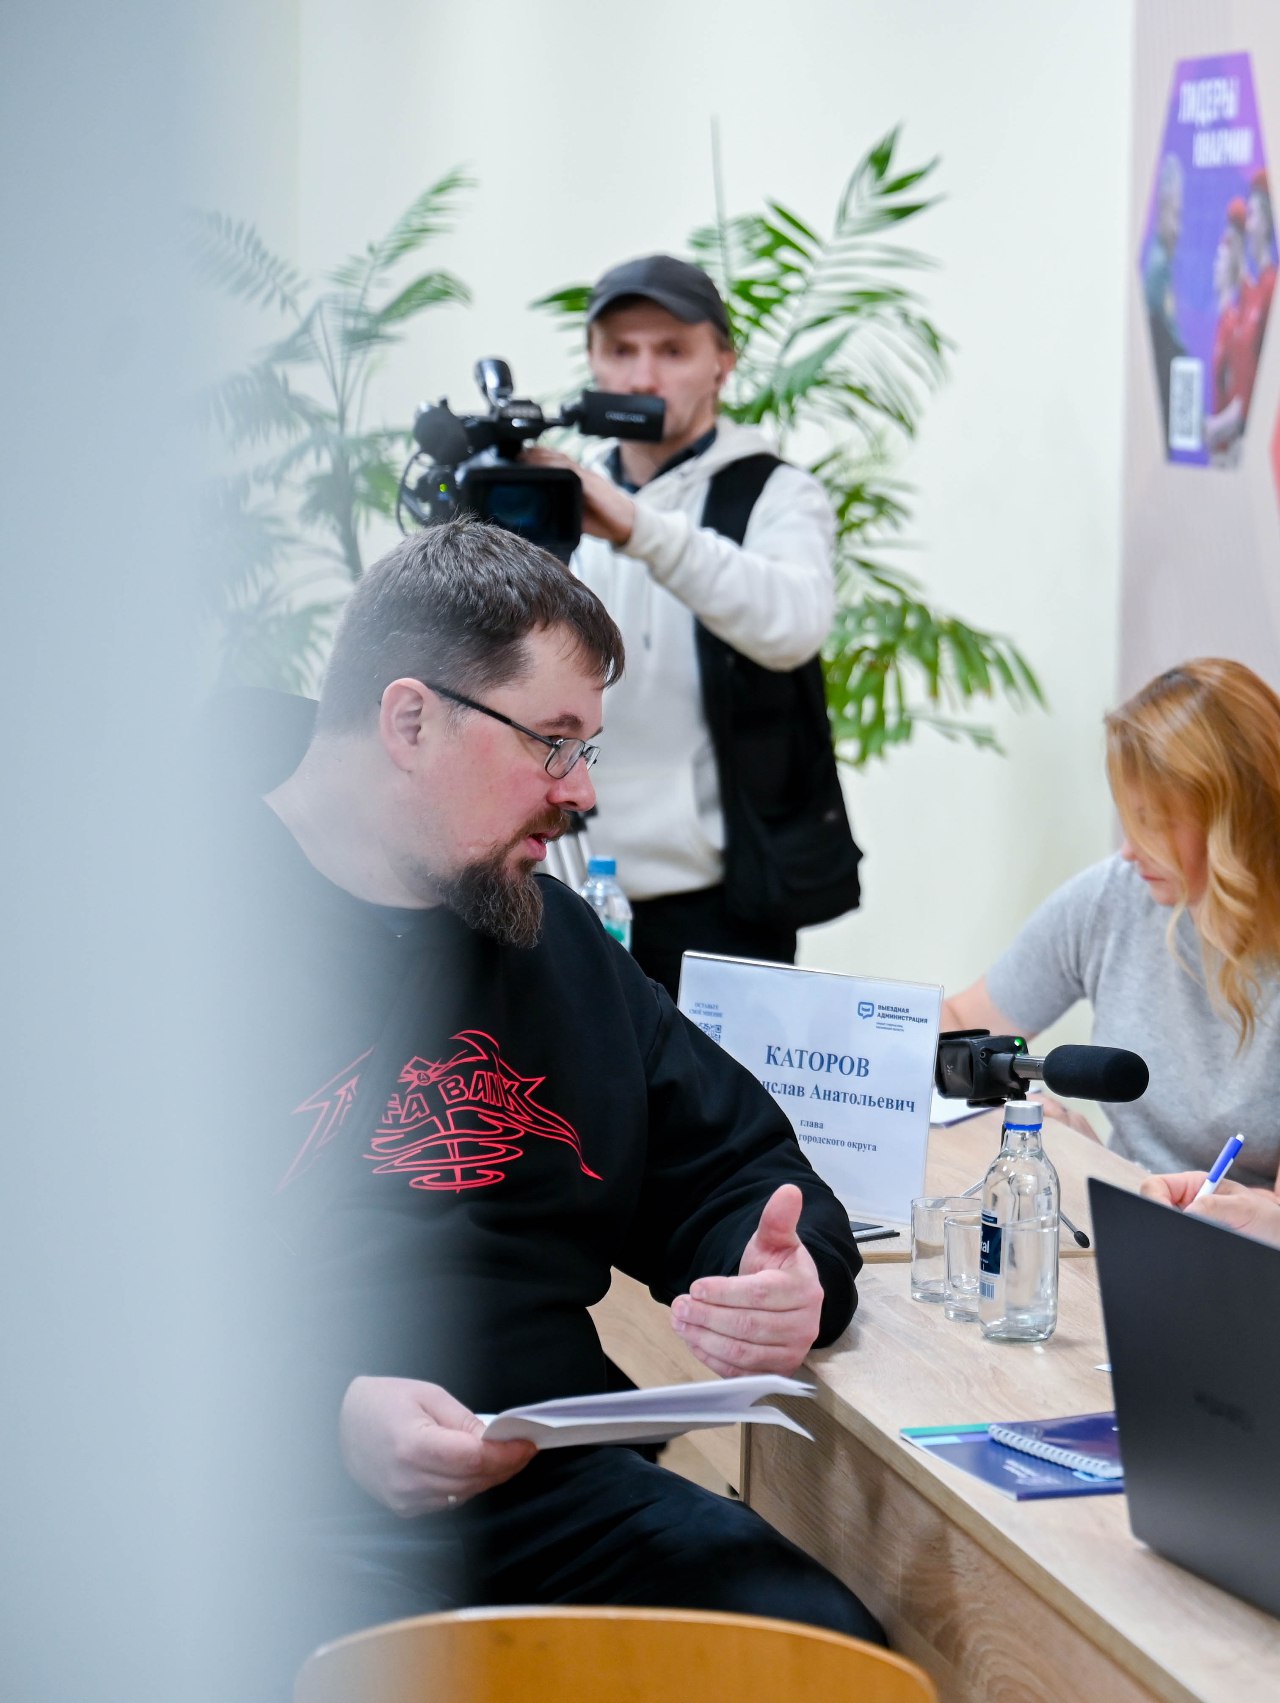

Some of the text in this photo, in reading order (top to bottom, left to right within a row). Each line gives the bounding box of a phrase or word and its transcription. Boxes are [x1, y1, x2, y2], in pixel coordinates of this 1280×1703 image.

[877, 1004, 910, 1014] ВЫЕЗДНАЯ
[876, 1012, 928, 1025] АДМИНИСТРАЦИЯ
[764, 1044, 870, 1078] КАТОРОВ
[762, 1080, 915, 1113] ислав Анатольевич
[800, 1119, 824, 1130] глава
[798, 1133, 877, 1153] городского округа
